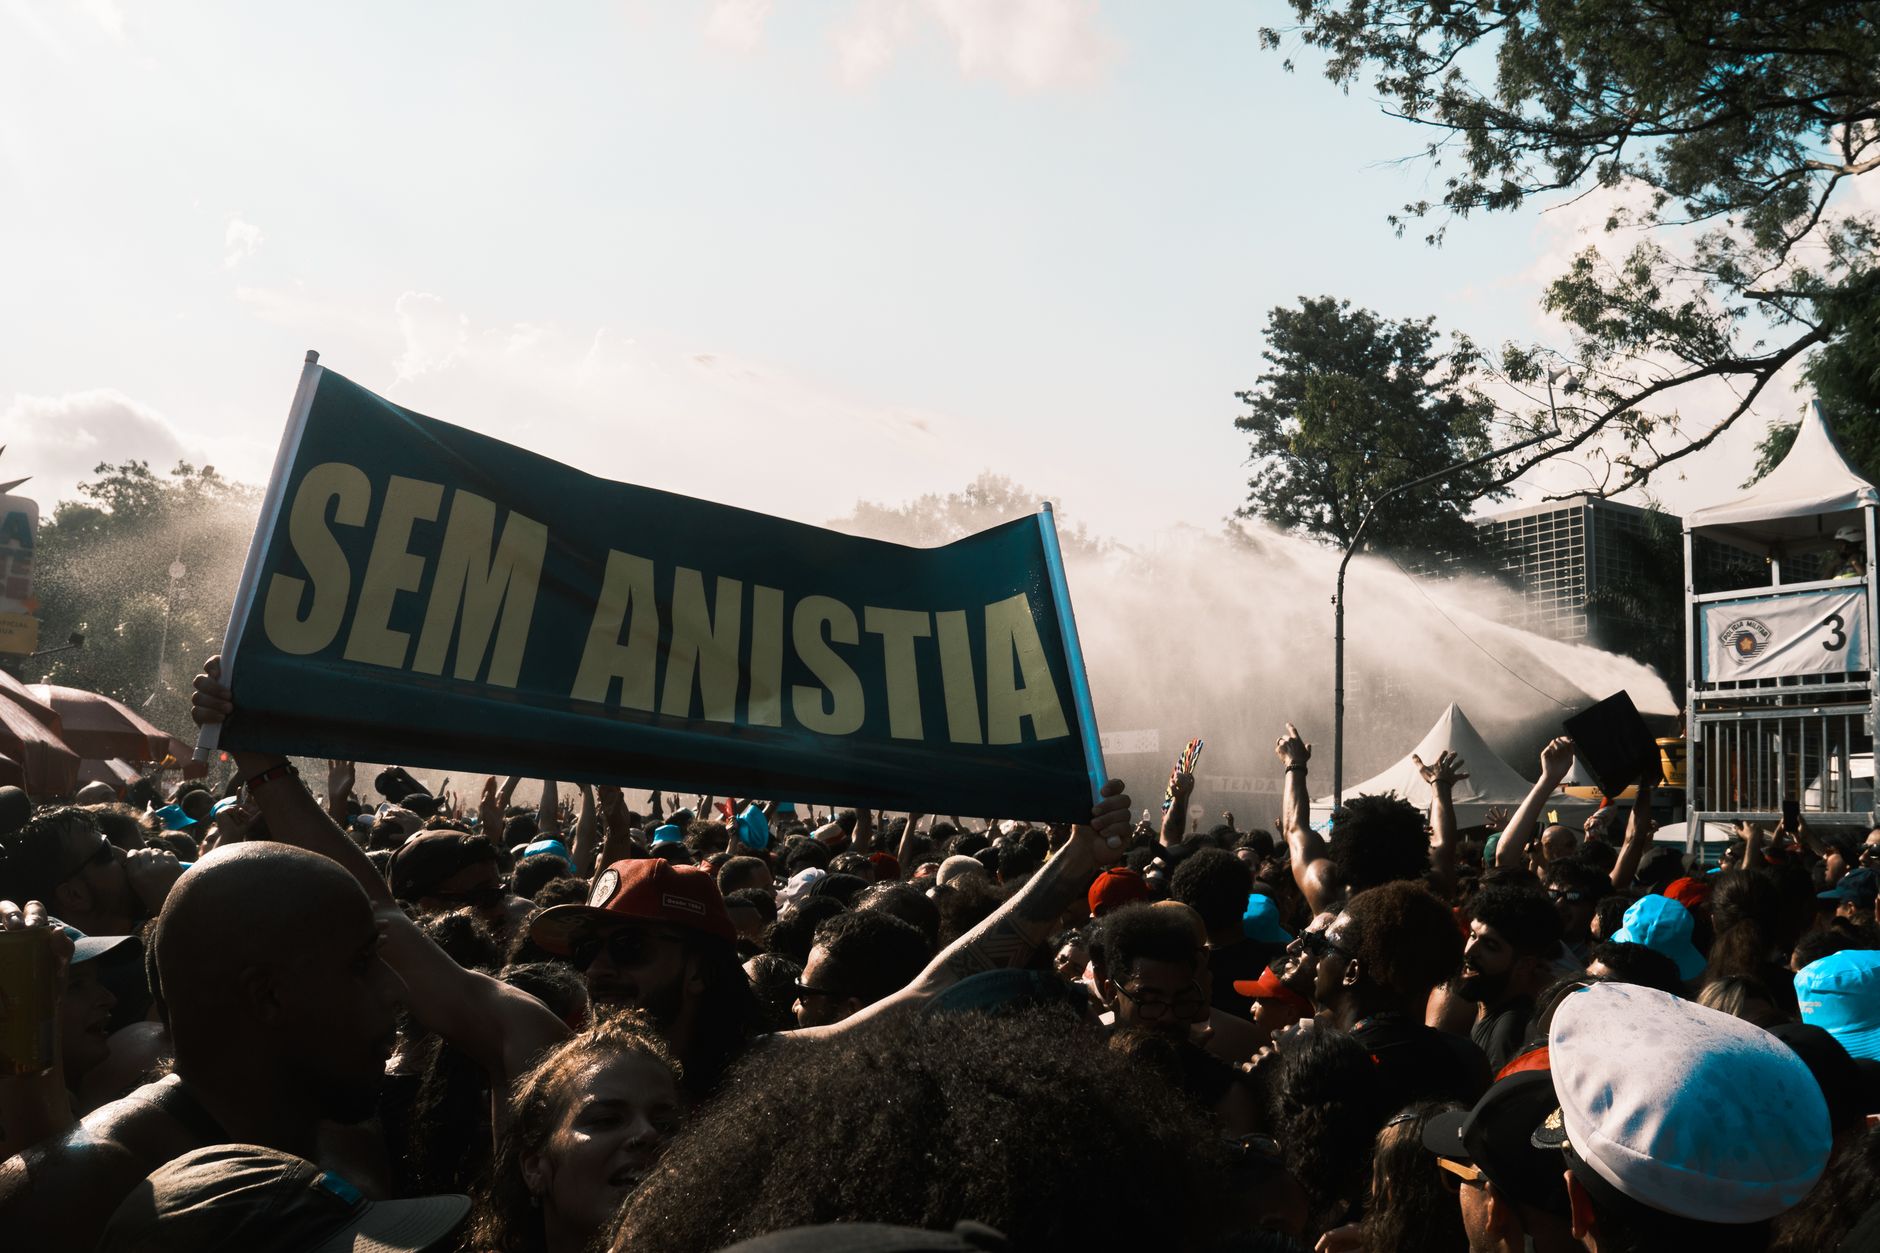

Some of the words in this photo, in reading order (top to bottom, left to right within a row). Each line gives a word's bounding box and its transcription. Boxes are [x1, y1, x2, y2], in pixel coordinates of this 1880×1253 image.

[263, 462, 549, 689] SEM
[569, 548, 1070, 745] ANISTIA
[1746, 620, 1769, 638] MILITAR
[1822, 614, 1847, 652] 3
[1222, 778, 1278, 792] TENDA
